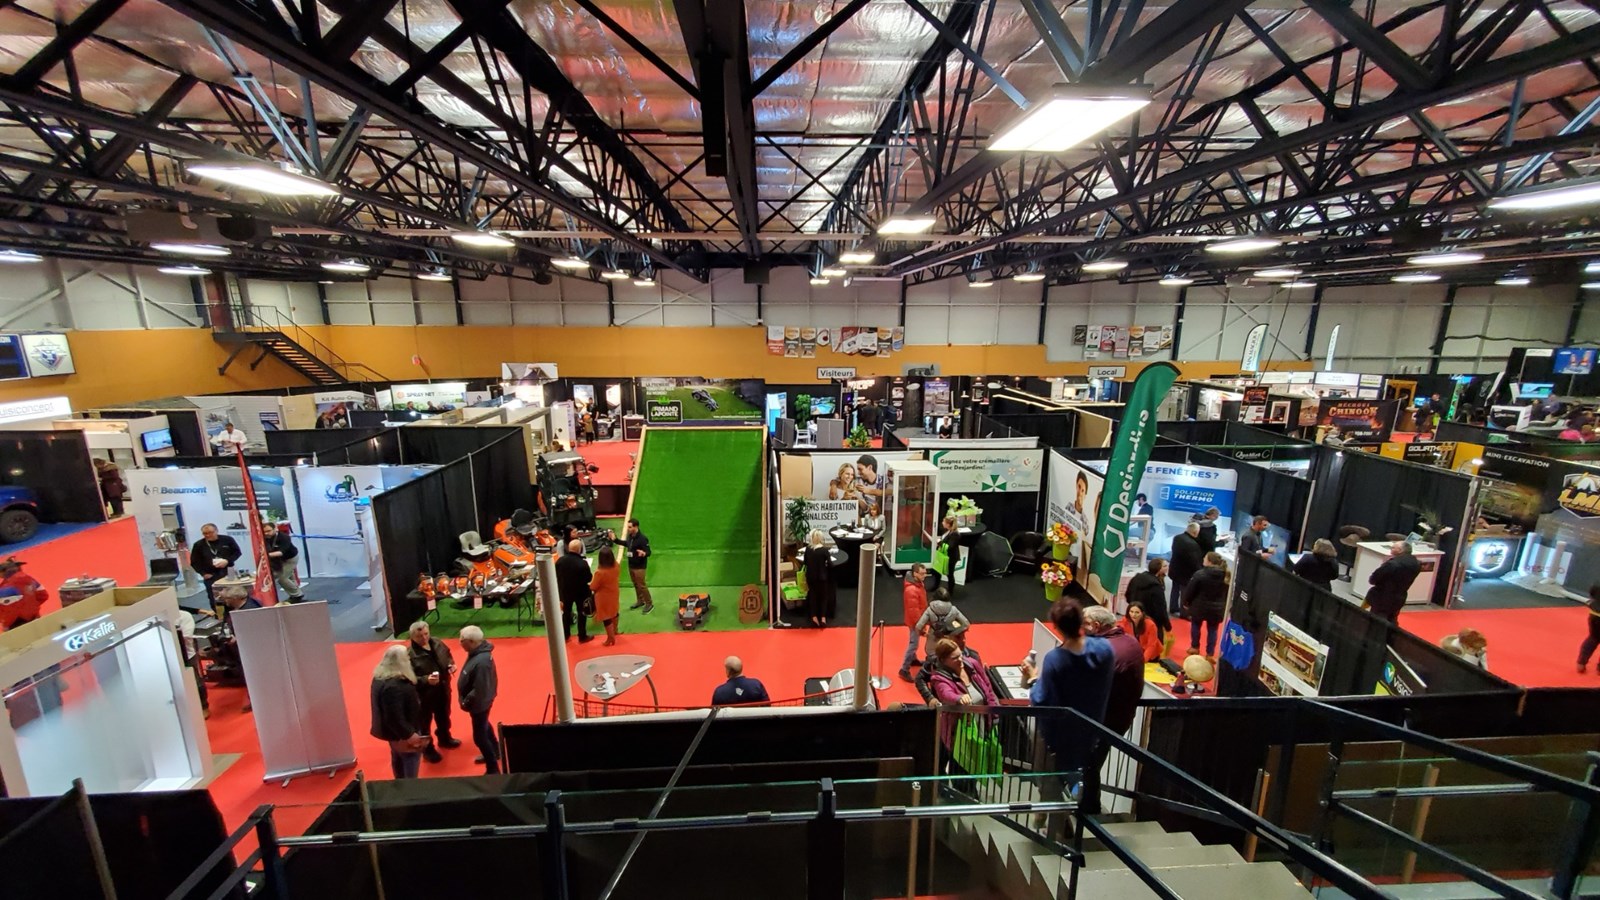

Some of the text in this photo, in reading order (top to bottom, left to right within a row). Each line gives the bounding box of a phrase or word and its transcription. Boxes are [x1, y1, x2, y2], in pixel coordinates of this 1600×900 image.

[1328, 406, 1378, 416] CHINOOK
[1262, 450, 1270, 458] C
[1109, 409, 1149, 524] Desjardins
[1156, 467, 1212, 478] FENÊTRES
[1175, 489, 1214, 497] SOLUTION
[1174, 494, 1212, 502] THERMO
[820, 502, 856, 511] HABITATION
[83, 622, 116, 644] Kalia
